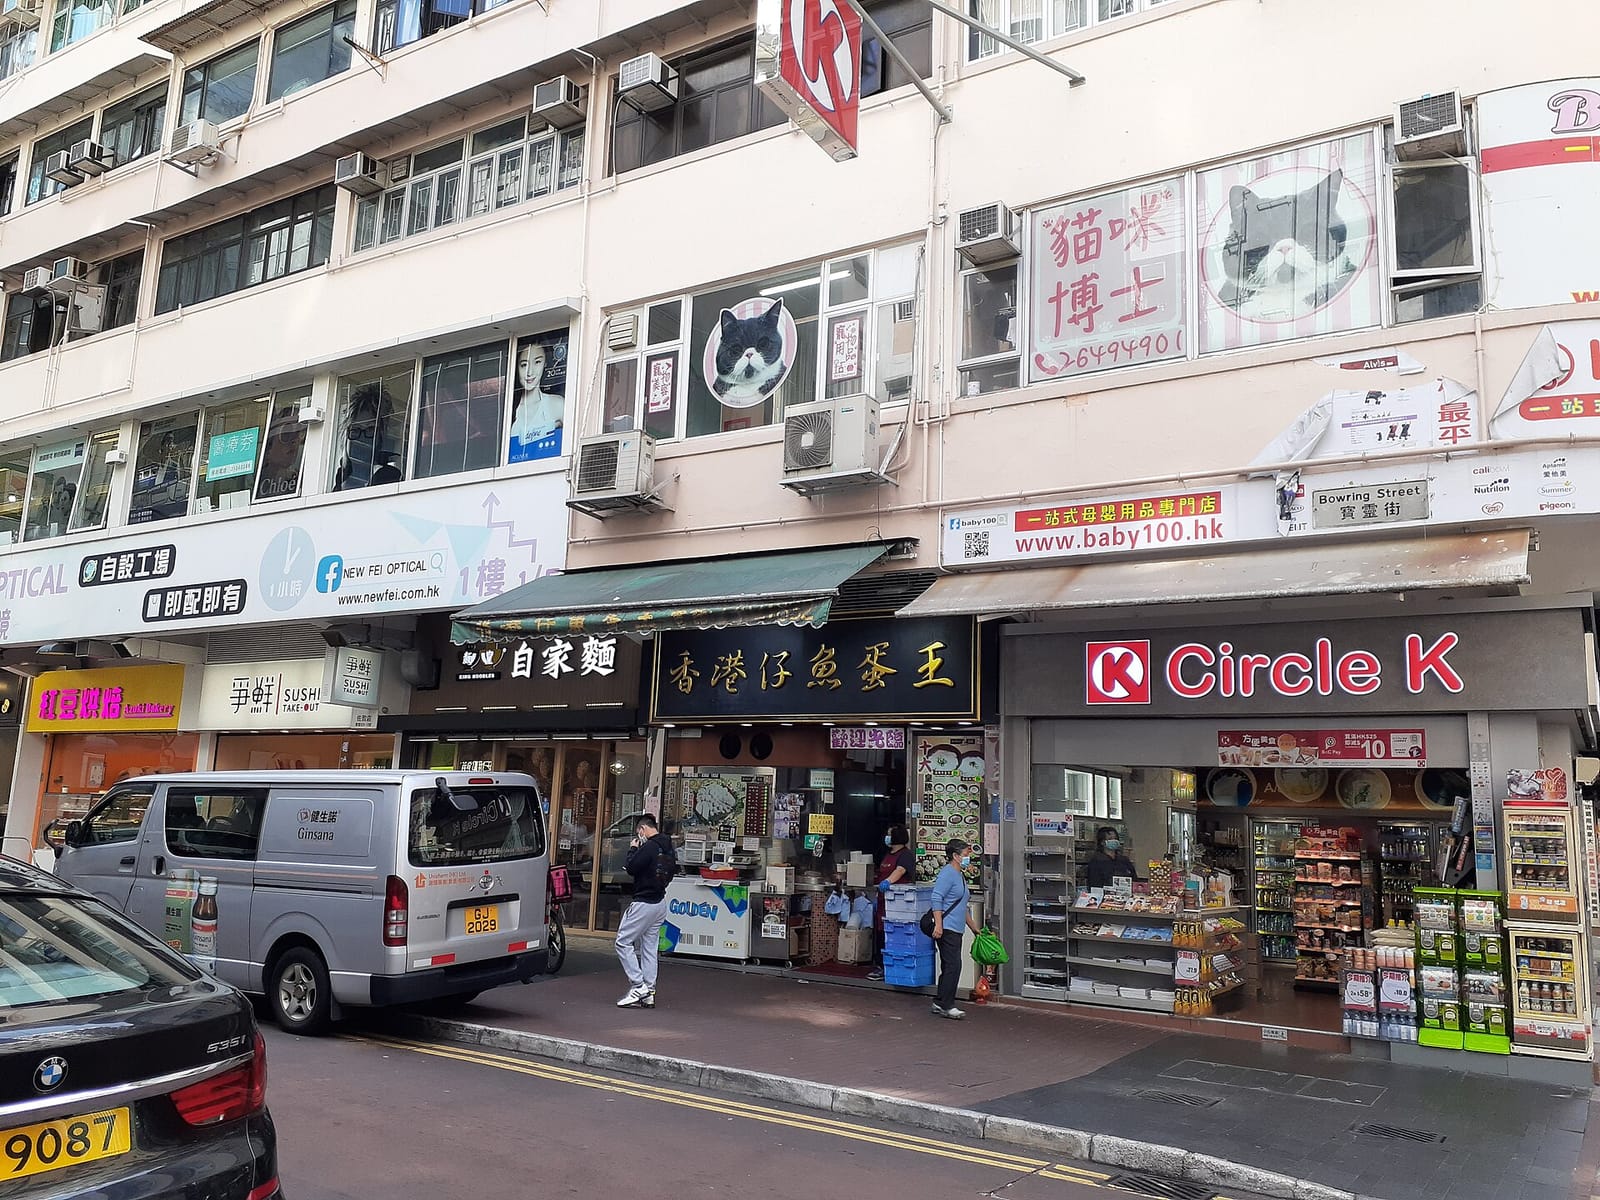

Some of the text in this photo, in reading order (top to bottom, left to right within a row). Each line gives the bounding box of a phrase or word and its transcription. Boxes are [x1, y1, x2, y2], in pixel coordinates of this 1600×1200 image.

[1049, 192, 1166, 268] 貓咪
[1048, 266, 1164, 337] 博士
[1058, 329, 1183, 372] 26494901
[1437, 384, 1472, 445] 最平
[260, 475, 297, 495] Chloé
[1319, 486, 1421, 504] Bowring Street
[1474, 485, 1510, 495] Nutrilon
[1541, 485, 1572, 494] Summer
[1027, 496, 1216, 525] 一站式母嬰用品專門店
[1340, 502, 1401, 520] 寶靈街
[1540, 501, 1571, 511] pigeon
[961, 517, 997, 529] baby100
[1015, 517, 1223, 552] www.baby100.hk
[101, 549, 171, 582] 自設工場
[343, 560, 427, 579] NEW FEI OPTICAL
[460, 557, 506, 597] 1樓
[164, 584, 241, 617] 即配即有
[338, 585, 440, 606] www.newfei.com.hk
[511, 636, 617, 680] 自家麵
[669, 641, 954, 694] 香港仔魚蛋王
[1166, 637, 1382, 699] Circle
[1405, 631, 1464, 694] K
[229, 676, 275, 714] 爭鮮
[284, 687, 321, 702] SUSHI
[343, 679, 370, 691] SUSHI
[343, 687, 369, 696] TAKE-OUT
[38, 687, 123, 720] 紅豆烘焙
[145, 702, 174, 714] Bakery
[283, 703, 320, 713] TAKE-OUT
[1361, 739, 1386, 759] 10
[297, 827, 335, 841] Ginsana
[474, 908, 490, 920] GJ
[669, 898, 718, 921] GOLDEN
[467, 919, 497, 934] 2029
[5, 1114, 117, 1173] 9087
